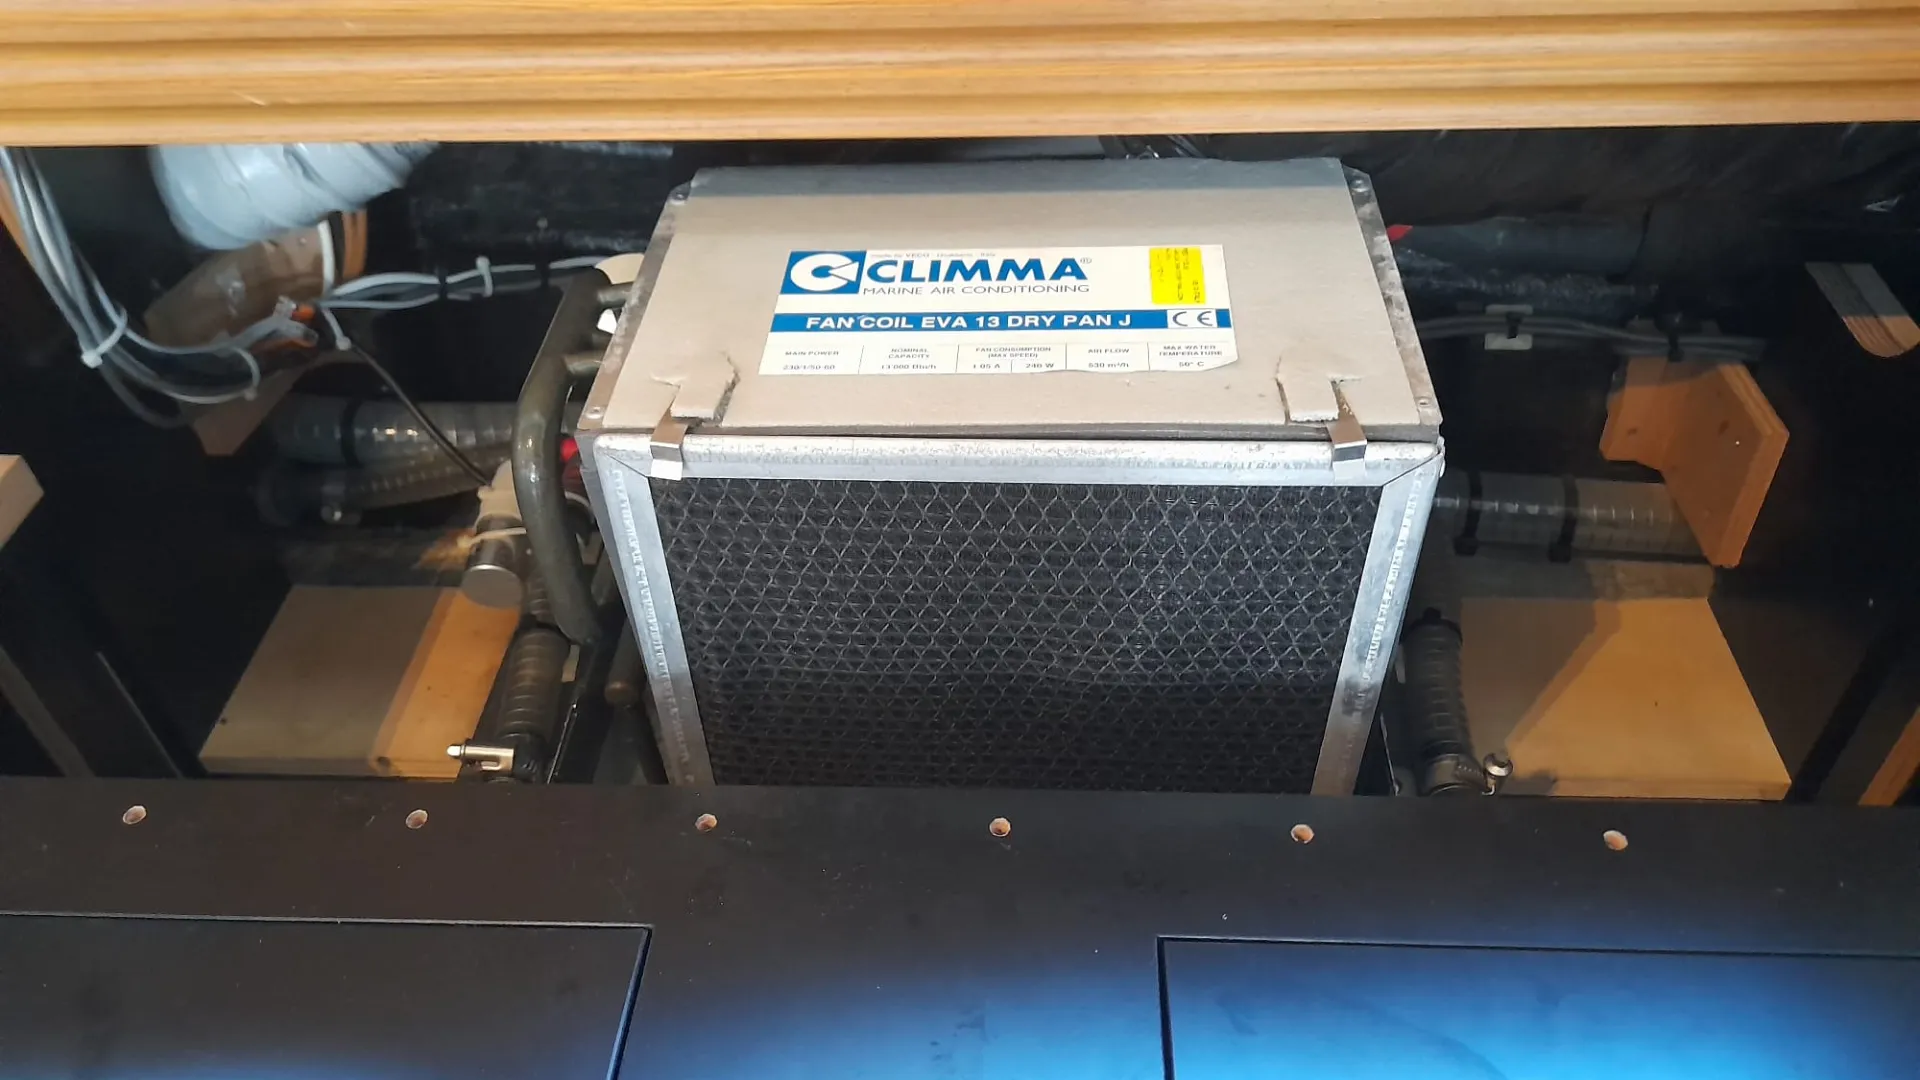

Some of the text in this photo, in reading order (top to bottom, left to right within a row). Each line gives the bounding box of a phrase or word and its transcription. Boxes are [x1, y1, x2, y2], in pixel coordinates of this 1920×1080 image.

[862, 284, 1090, 295] MARINE AIR CONDITIONING
[806, 314, 1131, 329] FAN COIL EVA 13 DRY PAN J
